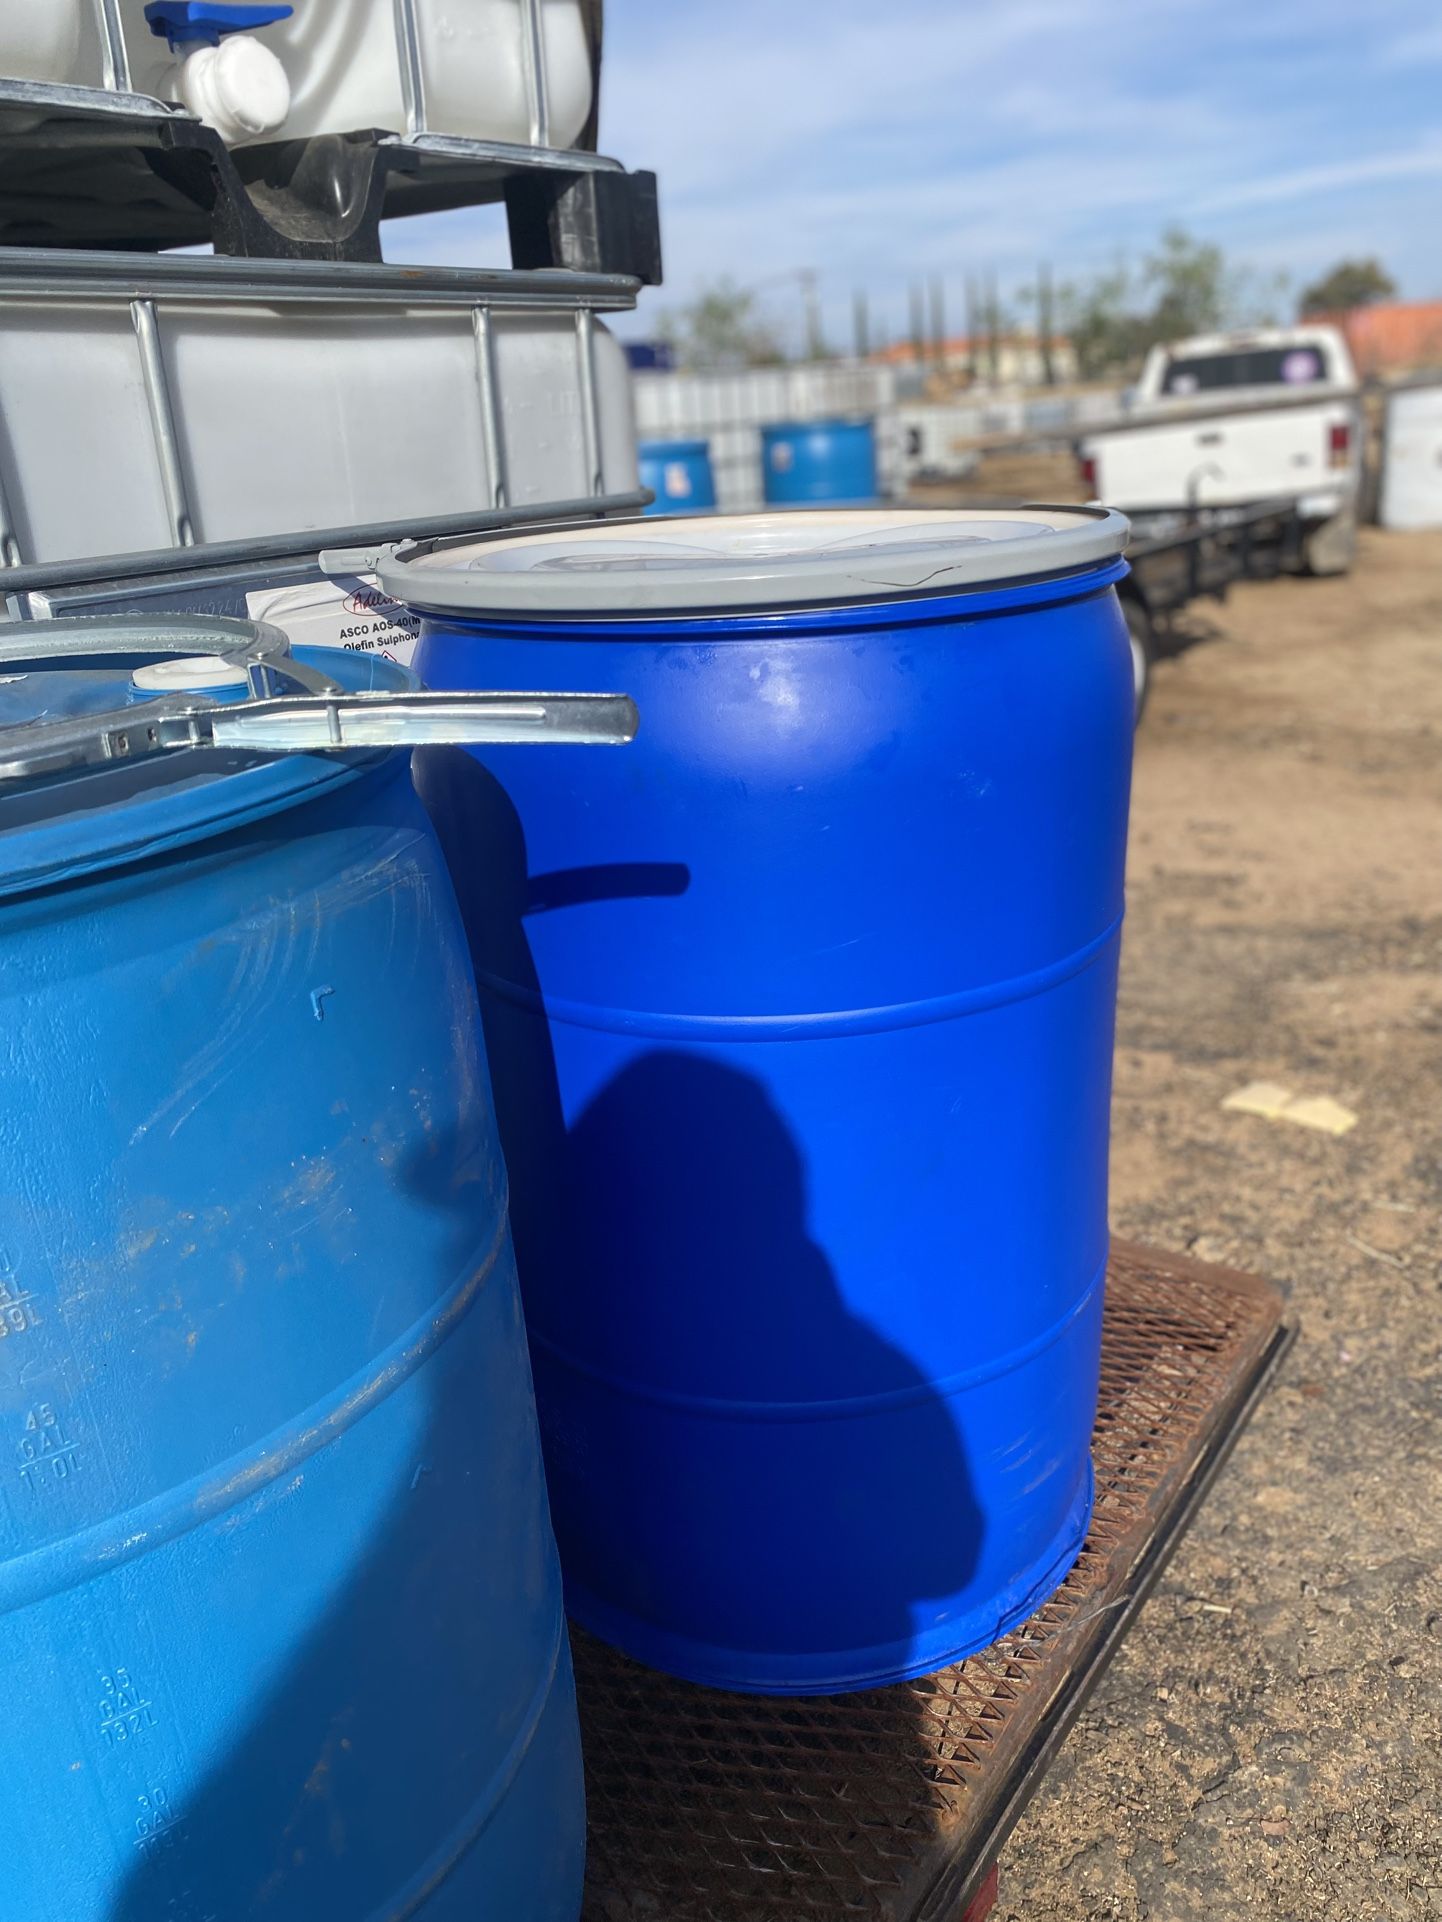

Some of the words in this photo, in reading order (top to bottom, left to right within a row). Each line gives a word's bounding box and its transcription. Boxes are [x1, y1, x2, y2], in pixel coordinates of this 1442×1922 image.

[340, 624, 369, 640] ASCO
[20, 1424, 71, 1460] GAL
[100, 1667, 131, 1696] 35
[101, 1709, 159, 1748] 132L
[137, 1787, 167, 1814] 30
